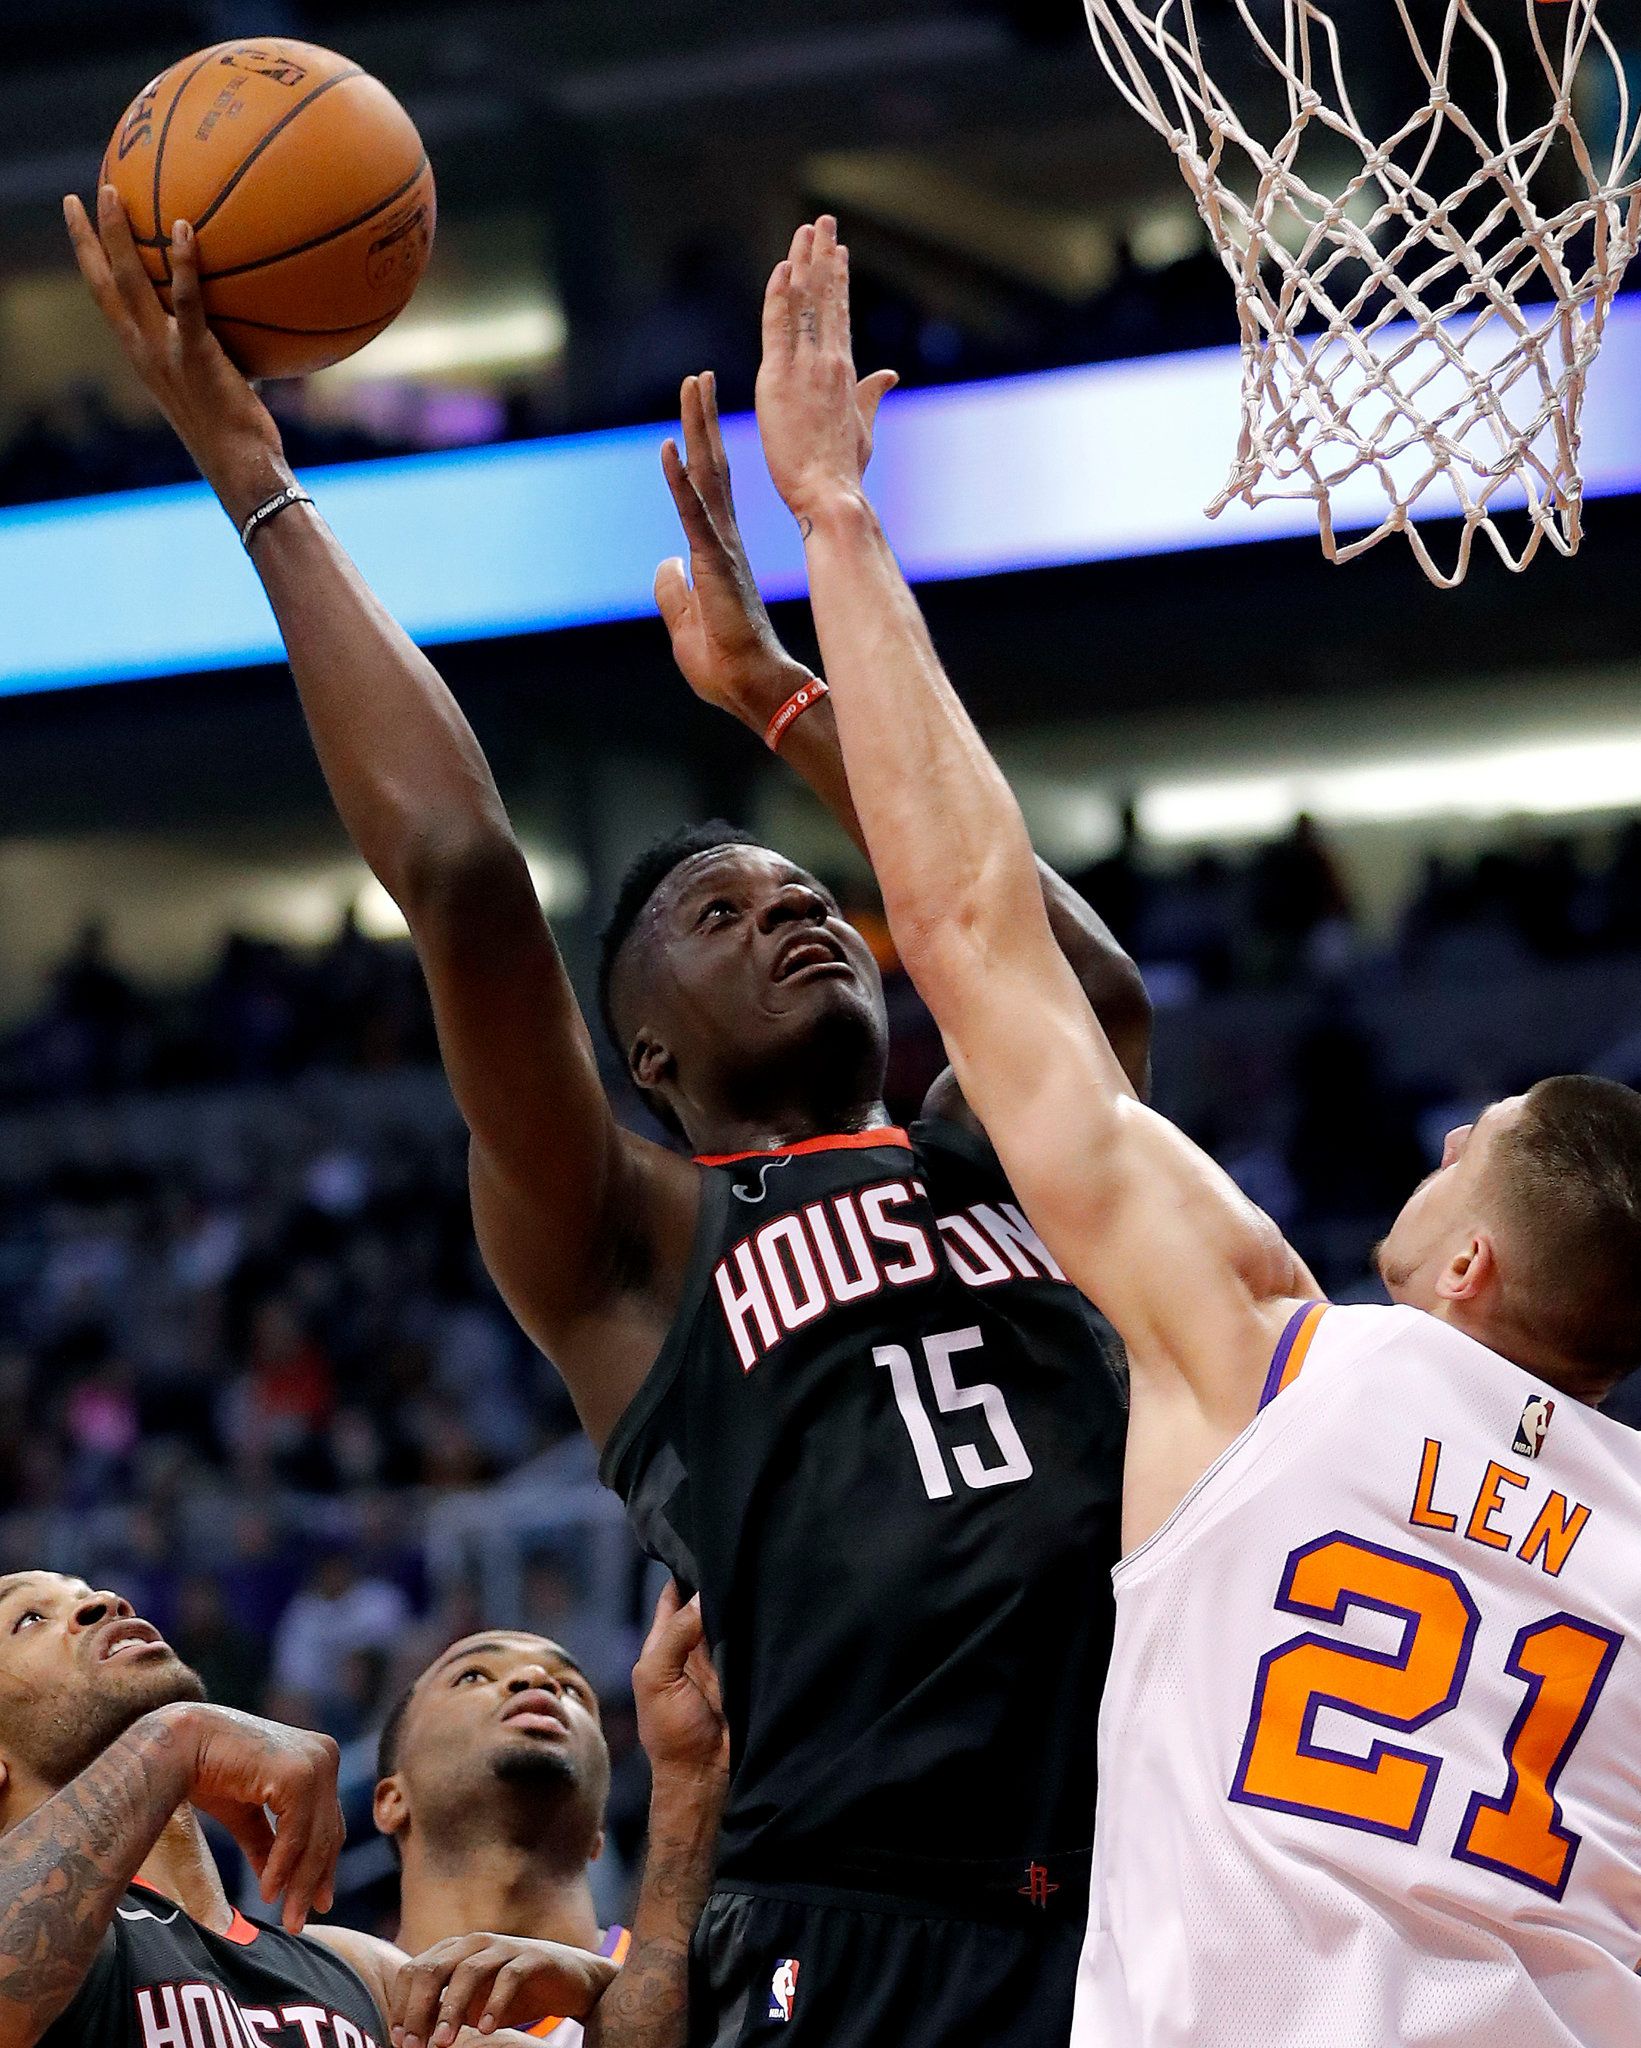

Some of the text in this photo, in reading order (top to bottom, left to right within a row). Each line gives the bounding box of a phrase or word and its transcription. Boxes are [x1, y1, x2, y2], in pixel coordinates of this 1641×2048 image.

[256, 495, 285, 519] GRIND
[713, 1177, 1072, 1375] HOUSON
[872, 1325, 1034, 1500] 15
[1513, 1441, 1532, 1455] NBA
[1409, 1437, 1592, 1577] LEN
[1228, 1530, 1625, 1903] 21
